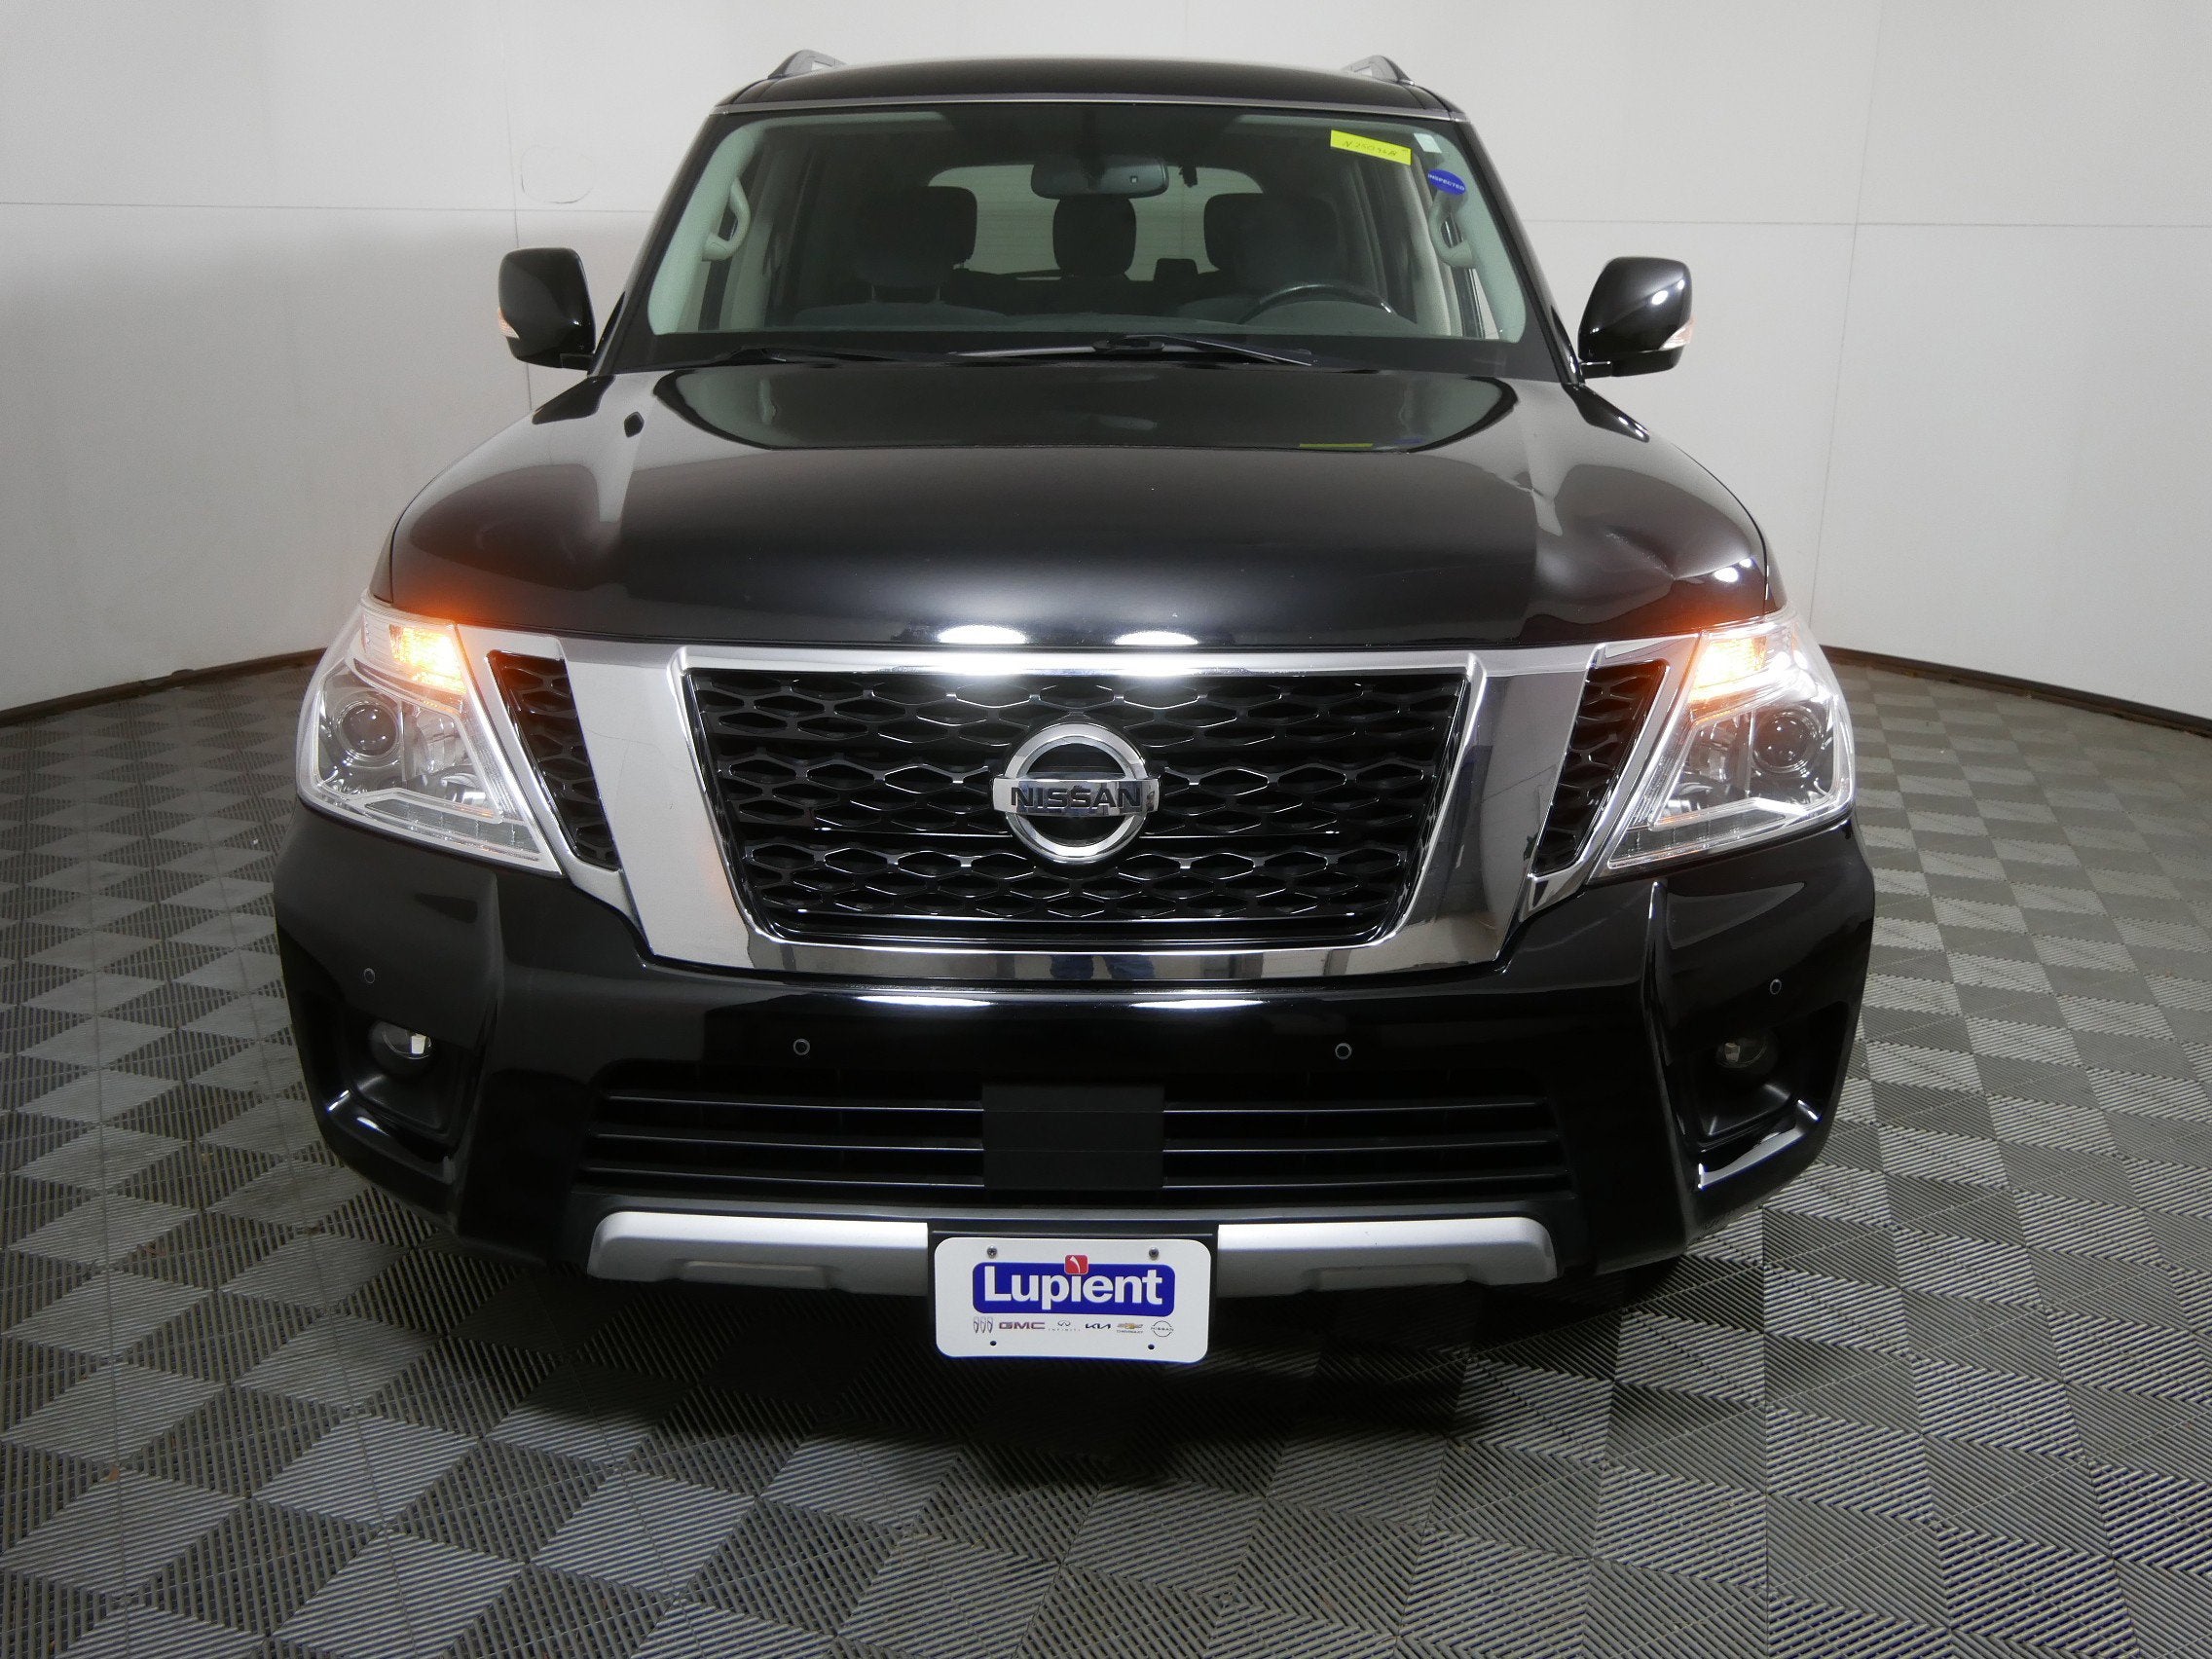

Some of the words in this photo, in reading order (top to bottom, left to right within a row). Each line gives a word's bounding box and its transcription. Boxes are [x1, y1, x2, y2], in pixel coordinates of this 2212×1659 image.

[1427, 173, 1465, 191] INSPECTED
[1011, 787, 1141, 808] NISSAN
[984, 1266, 1163, 1310] Lupient
[999, 1321, 1046, 1330] GMC
